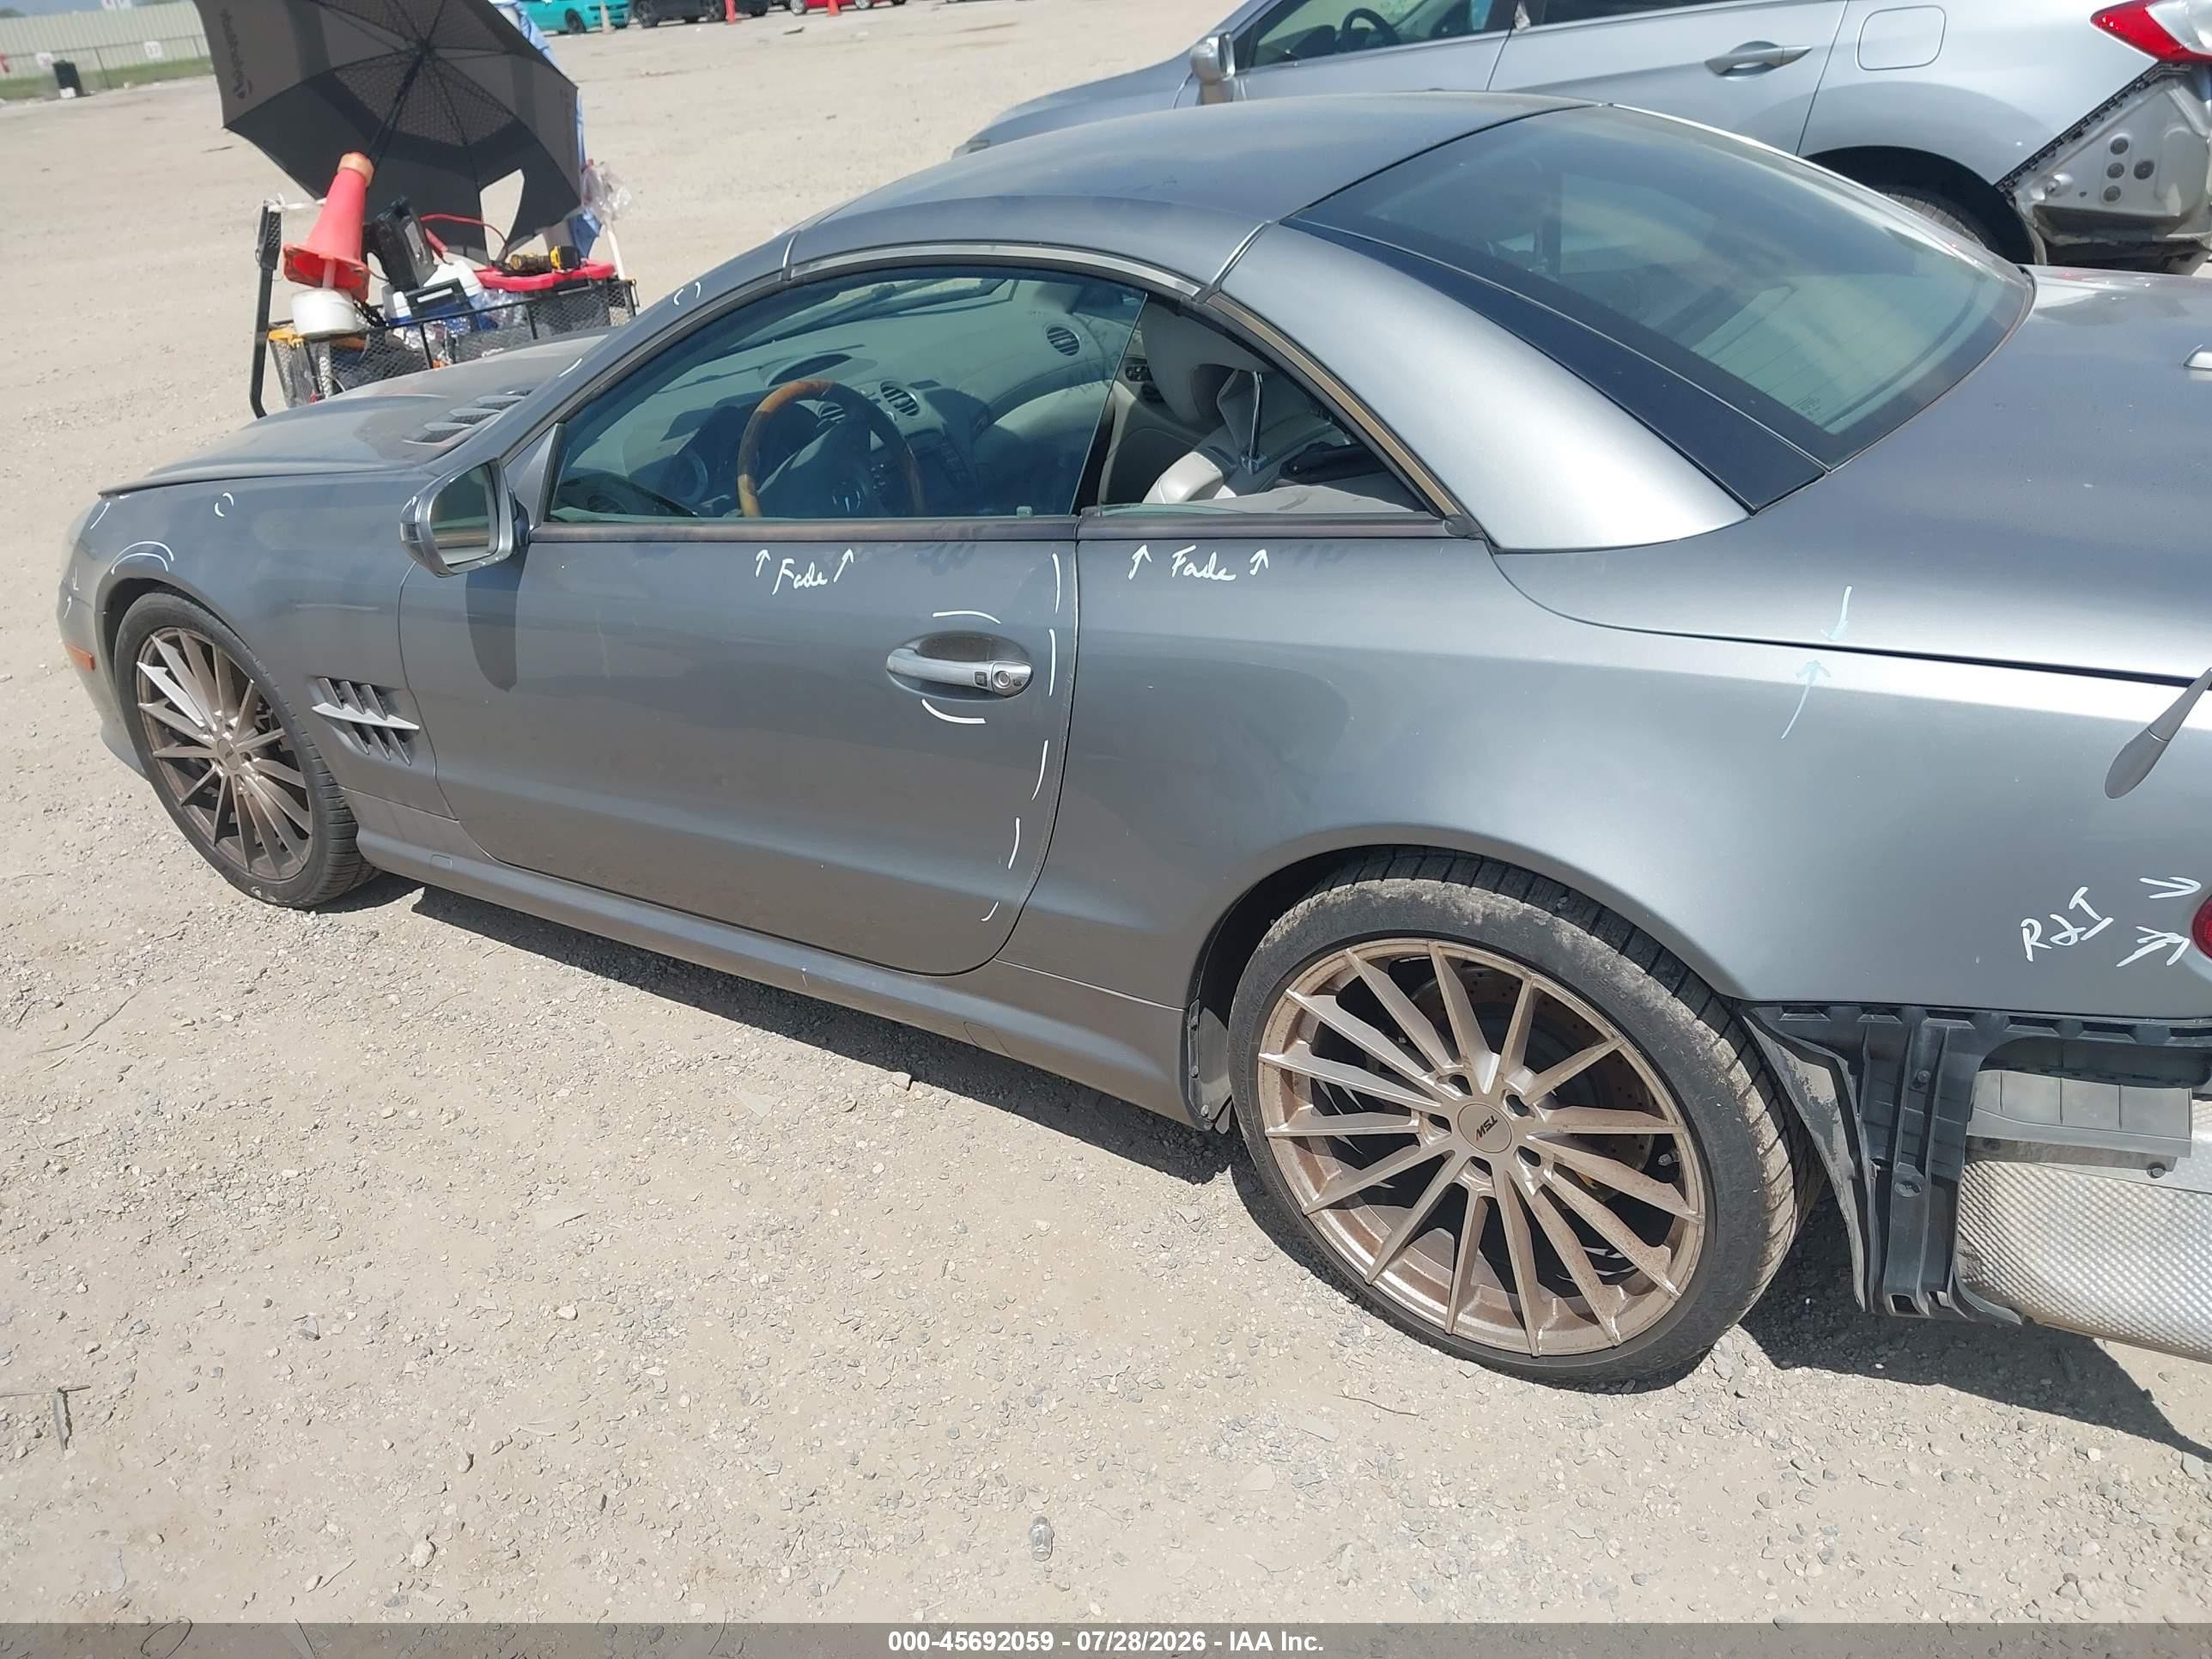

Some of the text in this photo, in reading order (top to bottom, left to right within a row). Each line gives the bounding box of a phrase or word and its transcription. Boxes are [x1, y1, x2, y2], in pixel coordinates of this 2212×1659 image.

[772, 557, 829, 596] Fade
[1171, 544, 1237, 581] Fade
[1475, 1115, 1498, 1141] TSW
